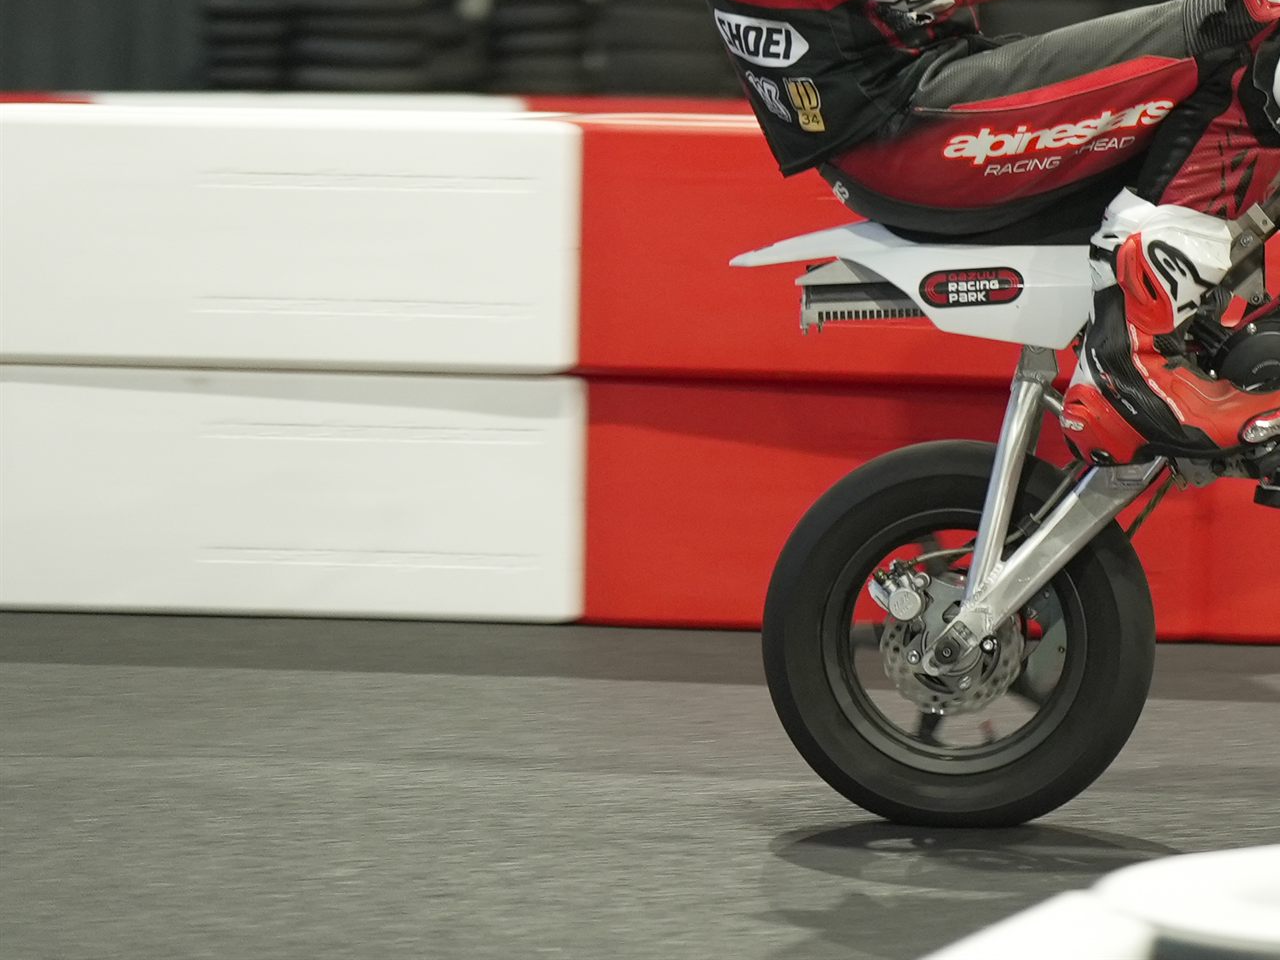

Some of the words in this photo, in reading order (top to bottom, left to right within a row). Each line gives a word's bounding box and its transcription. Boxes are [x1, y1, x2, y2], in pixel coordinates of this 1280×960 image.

[717, 15, 792, 60] SHOEI
[801, 113, 820, 126] 34
[943, 100, 1175, 165] alpinestars
[983, 156, 1062, 177] RACING
[1075, 136, 1136, 155] HEAD
